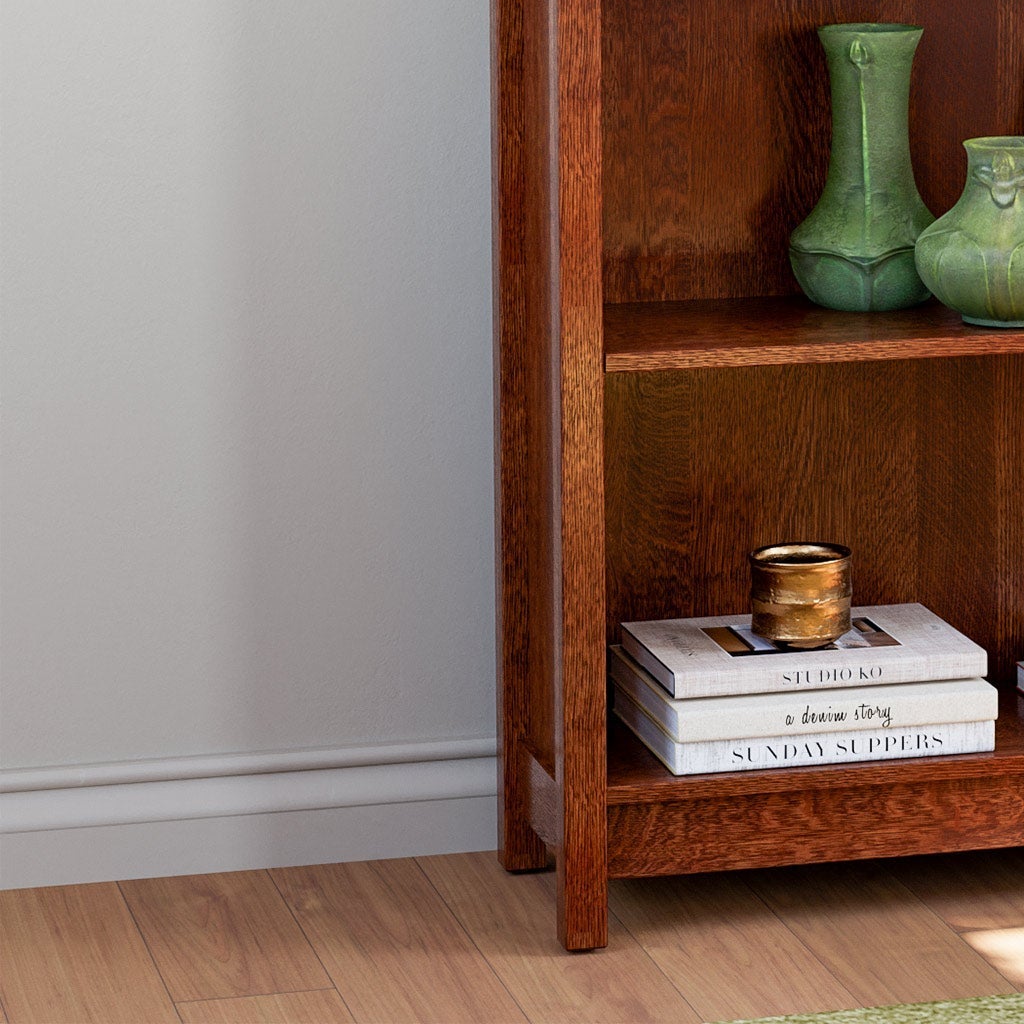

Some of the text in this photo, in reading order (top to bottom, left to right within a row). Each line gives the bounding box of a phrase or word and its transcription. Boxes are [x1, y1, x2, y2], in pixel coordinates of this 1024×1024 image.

[782, 666, 882, 685] STUDIO KO
[785, 703, 893, 728] a denim story
[731, 733, 943, 763] SUNDAY SUPPERS
